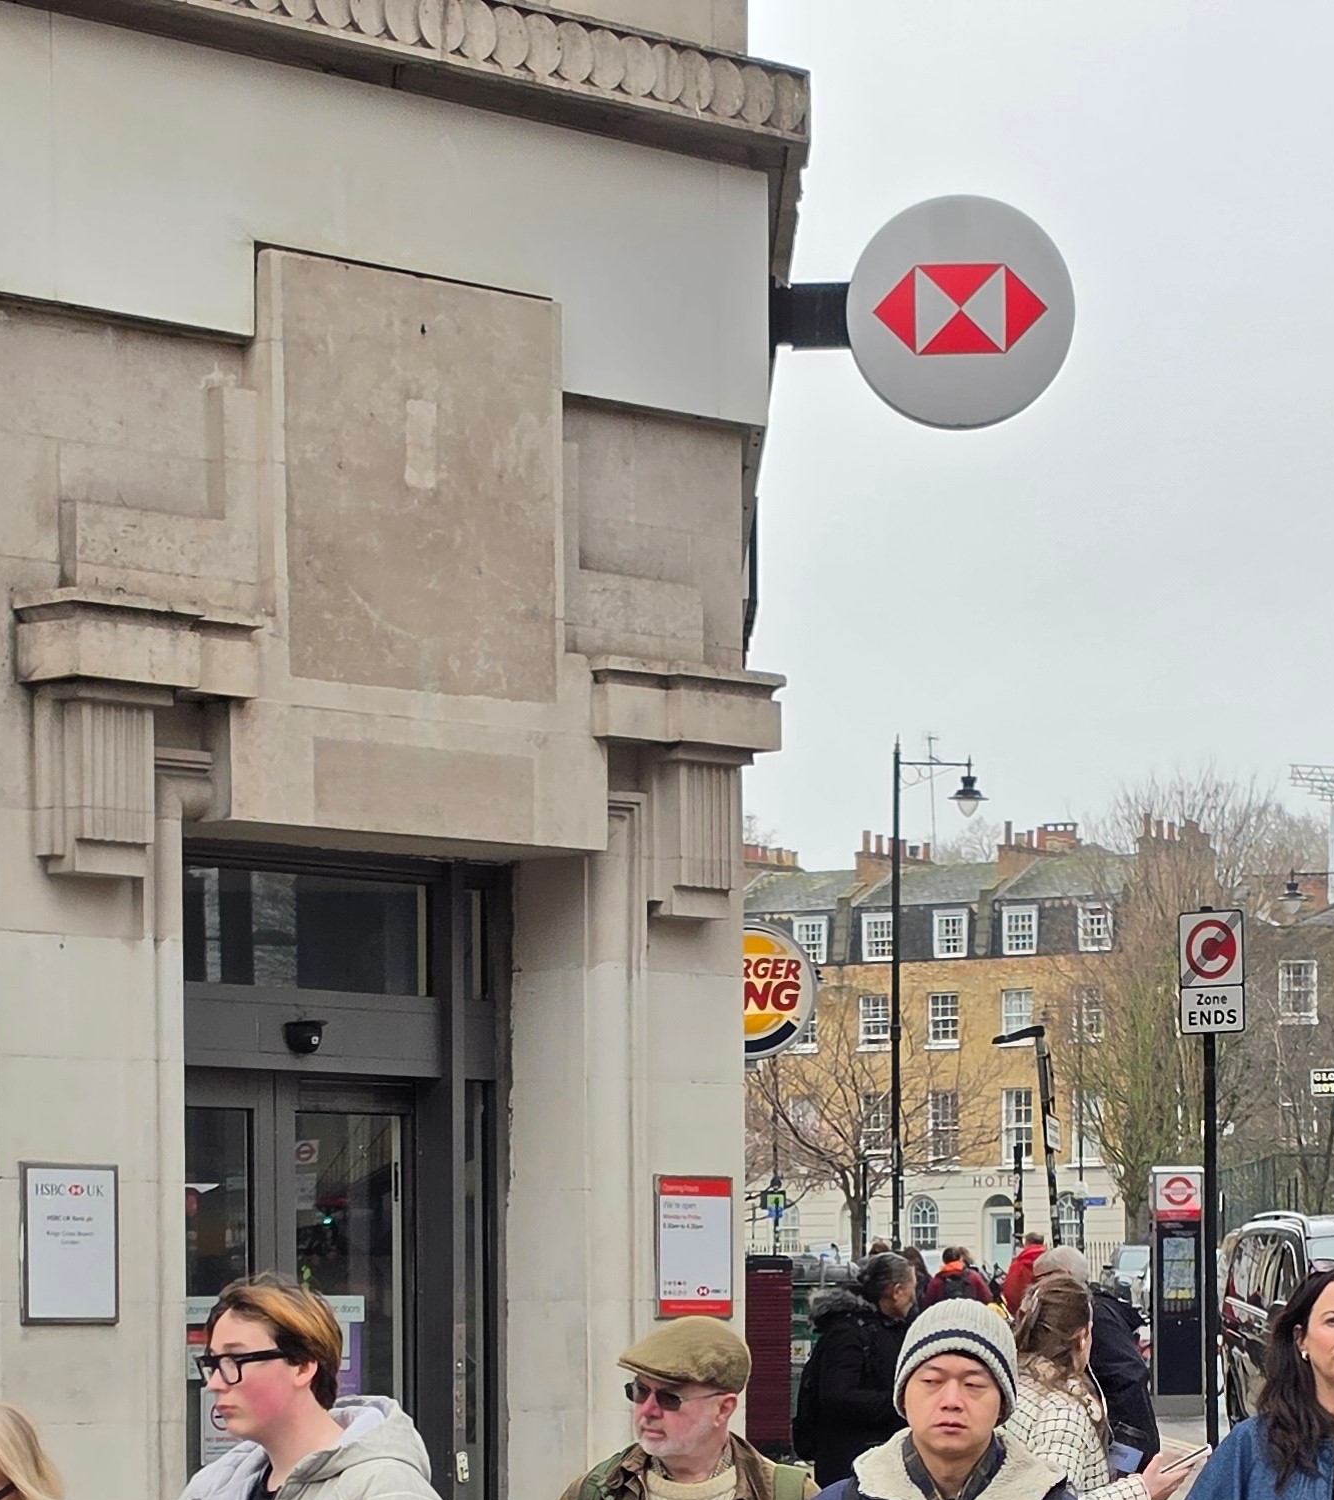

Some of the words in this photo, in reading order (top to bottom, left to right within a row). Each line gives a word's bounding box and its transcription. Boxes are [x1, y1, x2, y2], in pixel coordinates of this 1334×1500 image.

[743, 957, 801, 980] RGER
[744, 980, 801, 1011] NG
[1196, 993, 1228, 1006] Zone
[1188, 1008, 1237, 1026] ENDS
[973, 1173, 1018, 1187] HOTE
[35, 1183, 66, 1197] HSBC
[87, 1184, 104, 1197] UK
